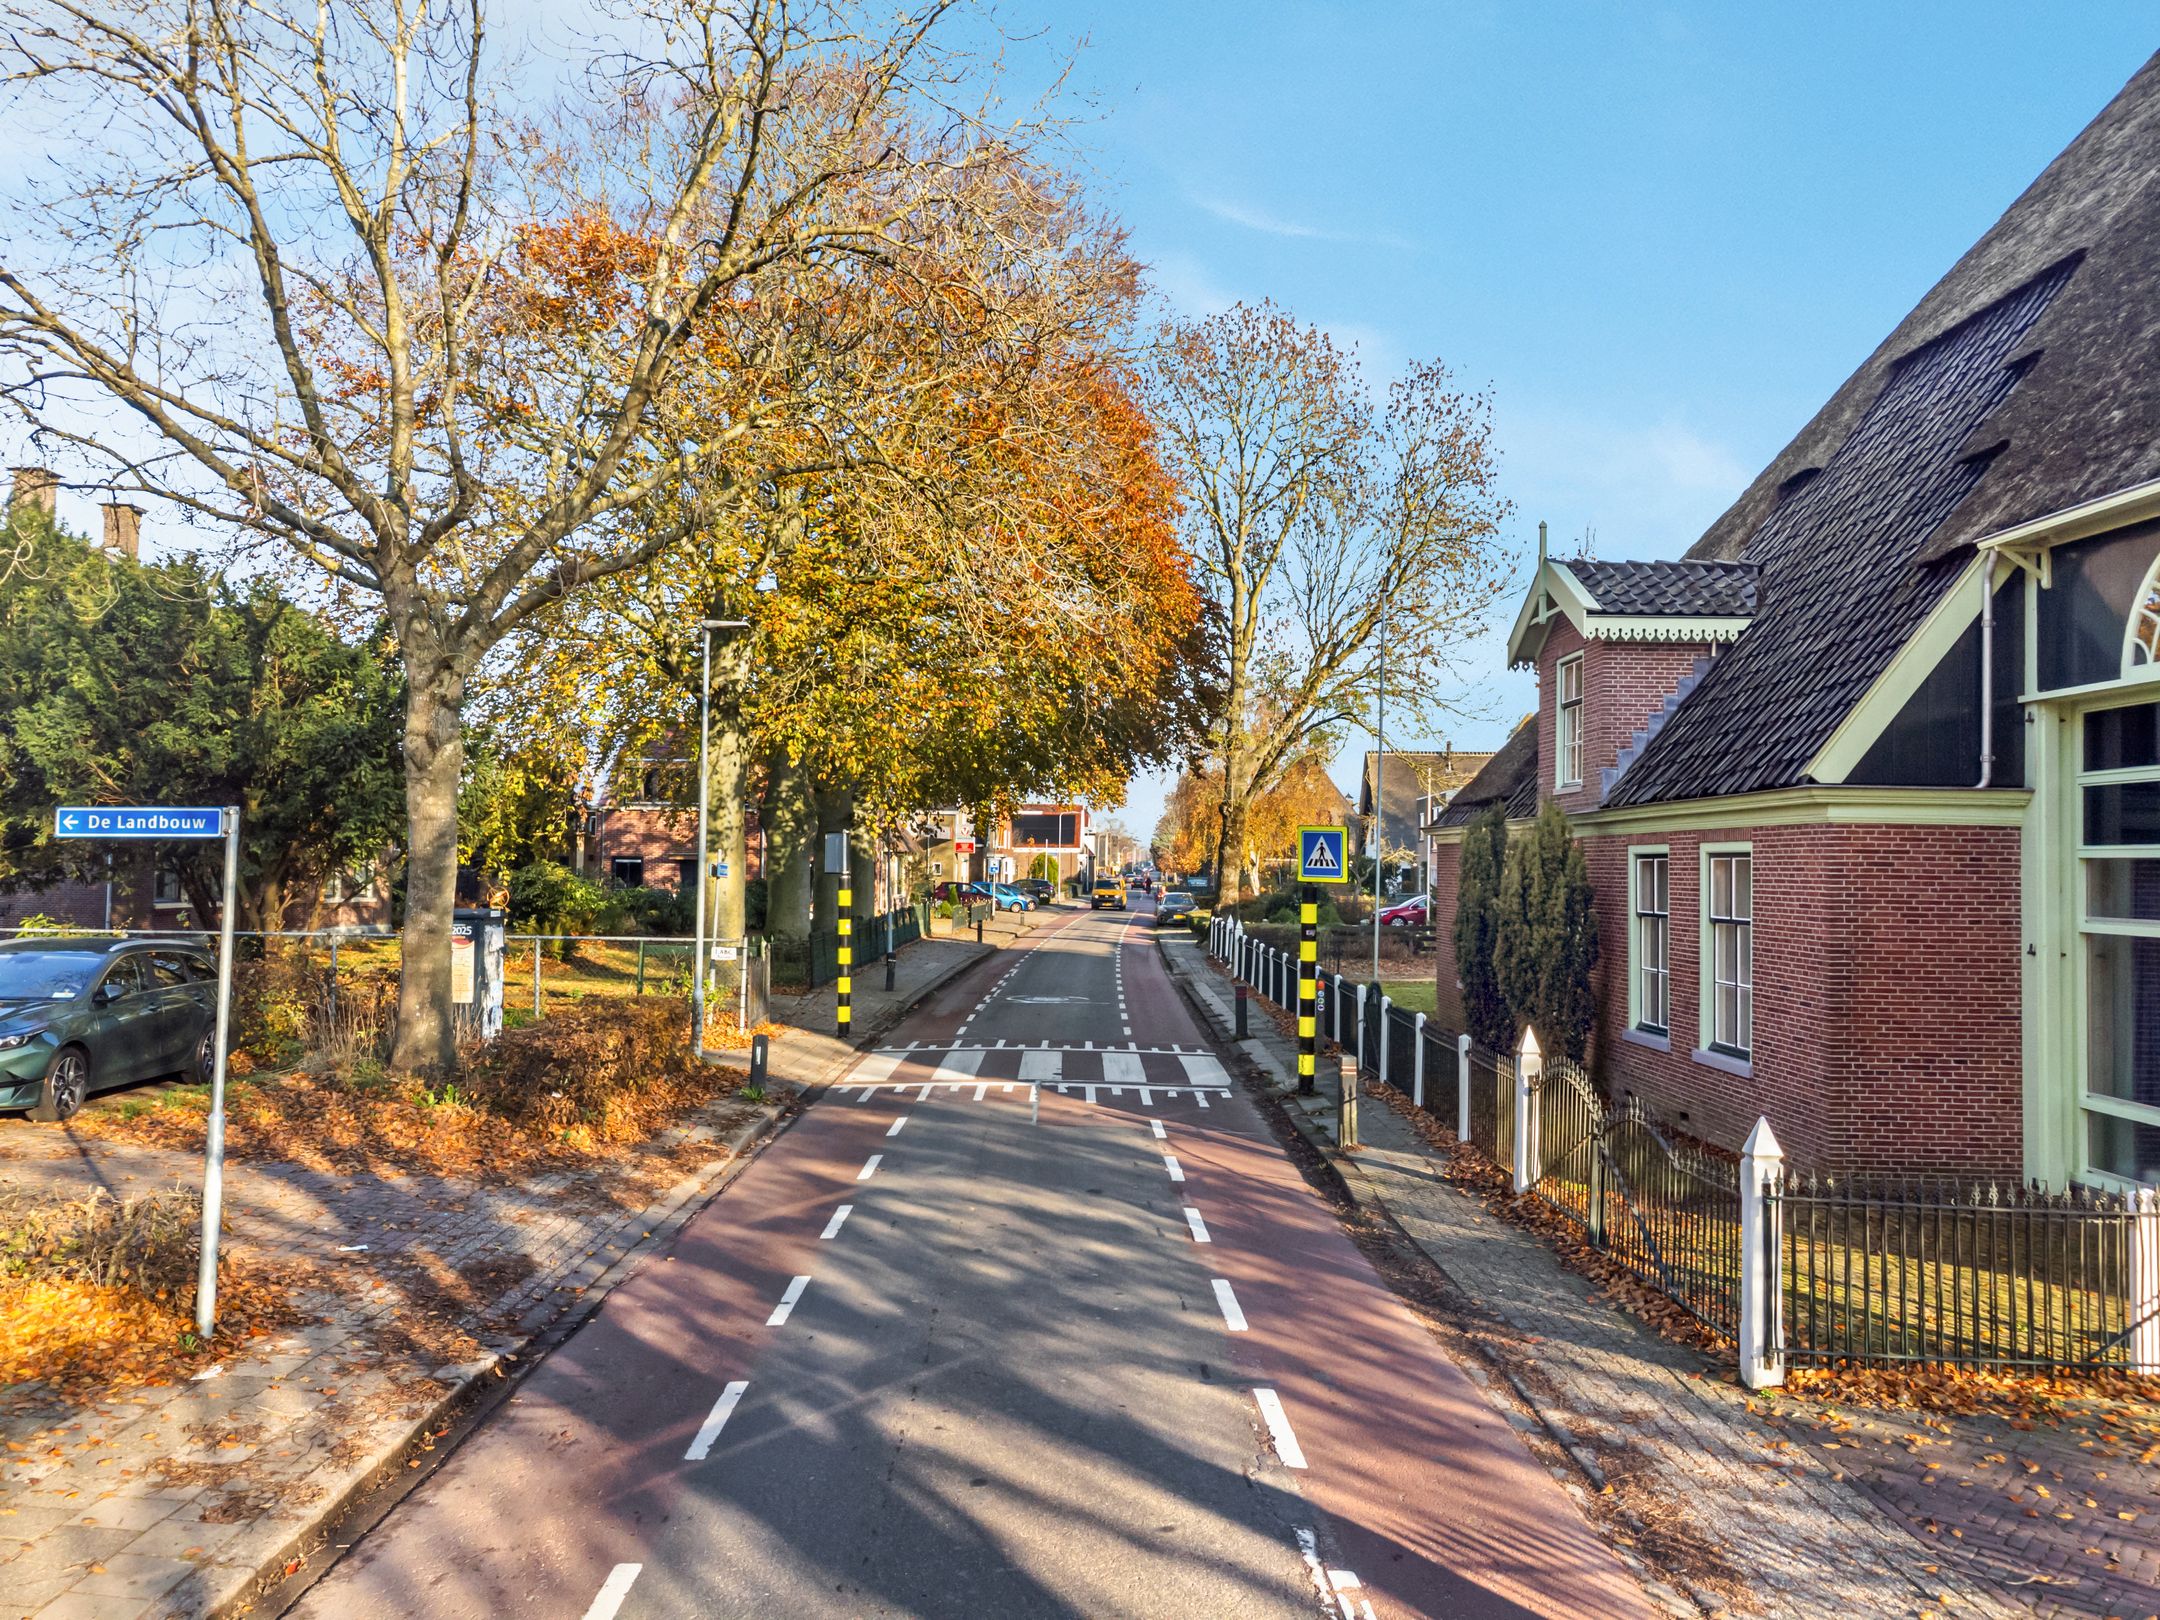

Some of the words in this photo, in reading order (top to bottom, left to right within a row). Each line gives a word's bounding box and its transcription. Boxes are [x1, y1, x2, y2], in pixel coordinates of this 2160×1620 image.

[88, 815, 110, 829] De
[117, 815, 206, 829] Landbouw
[452, 926, 472, 935] 2025
